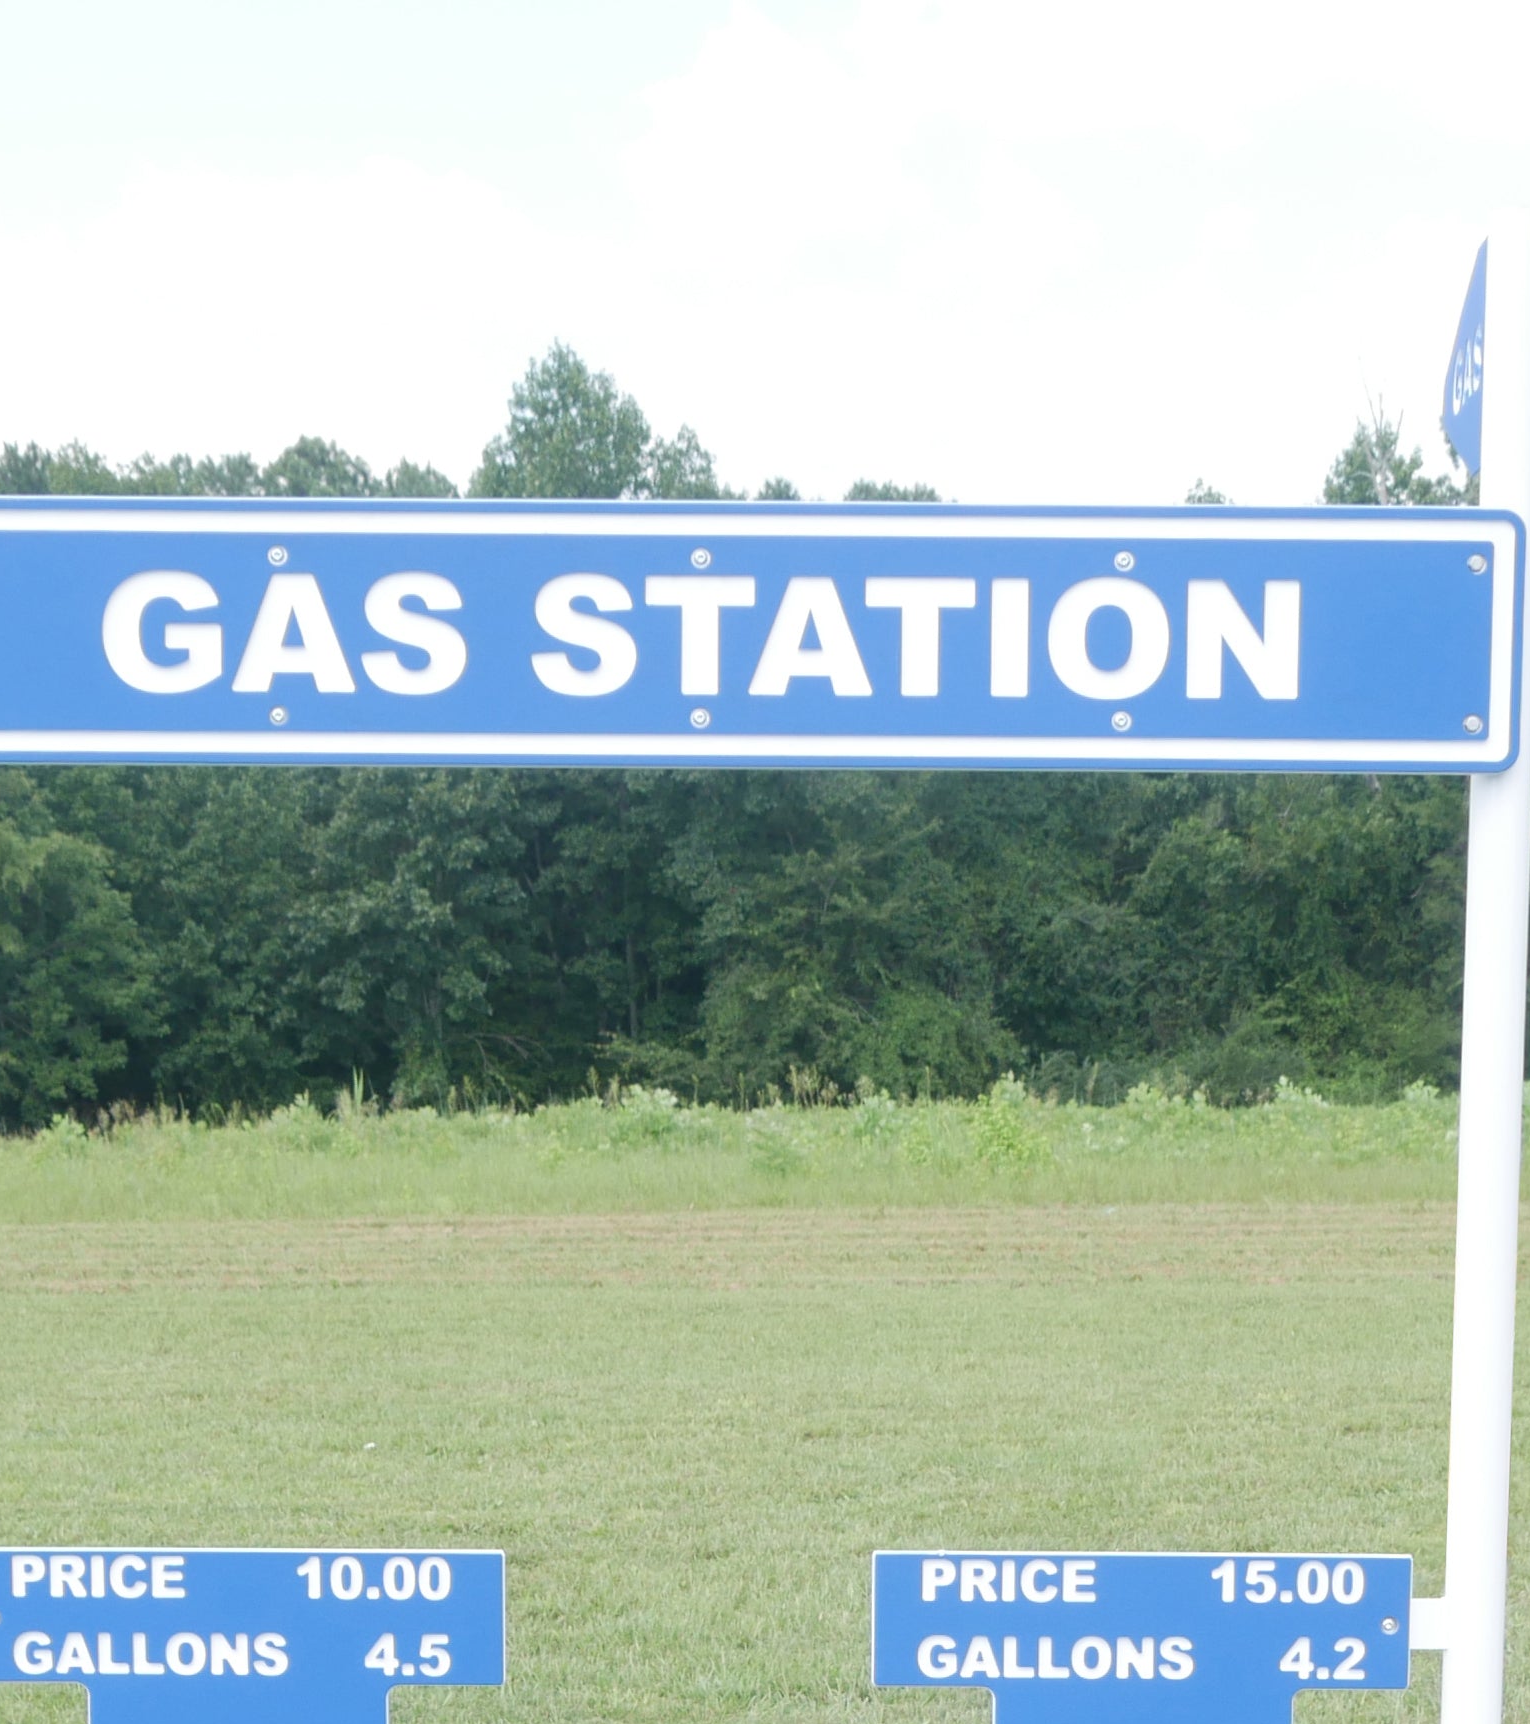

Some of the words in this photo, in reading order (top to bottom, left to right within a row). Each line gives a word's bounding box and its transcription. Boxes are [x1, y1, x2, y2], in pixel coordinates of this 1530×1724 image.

[1452, 323, 1483, 417] GAS
[101, 569, 469, 697] GAS
[530, 572, 1302, 702] STATION
[11, 1553, 188, 1600] PRICE
[296, 1555, 453, 1602] 10.00
[921, 1558, 1098, 1604] PRICE
[1210, 1558, 1367, 1605] 15.00
[12, 1630, 290, 1677] GALLONS
[364, 1632, 453, 1678] 4.5
[916, 1634, 1196, 1681] GALLONS
[1278, 1636, 1368, 1681] 4.2
